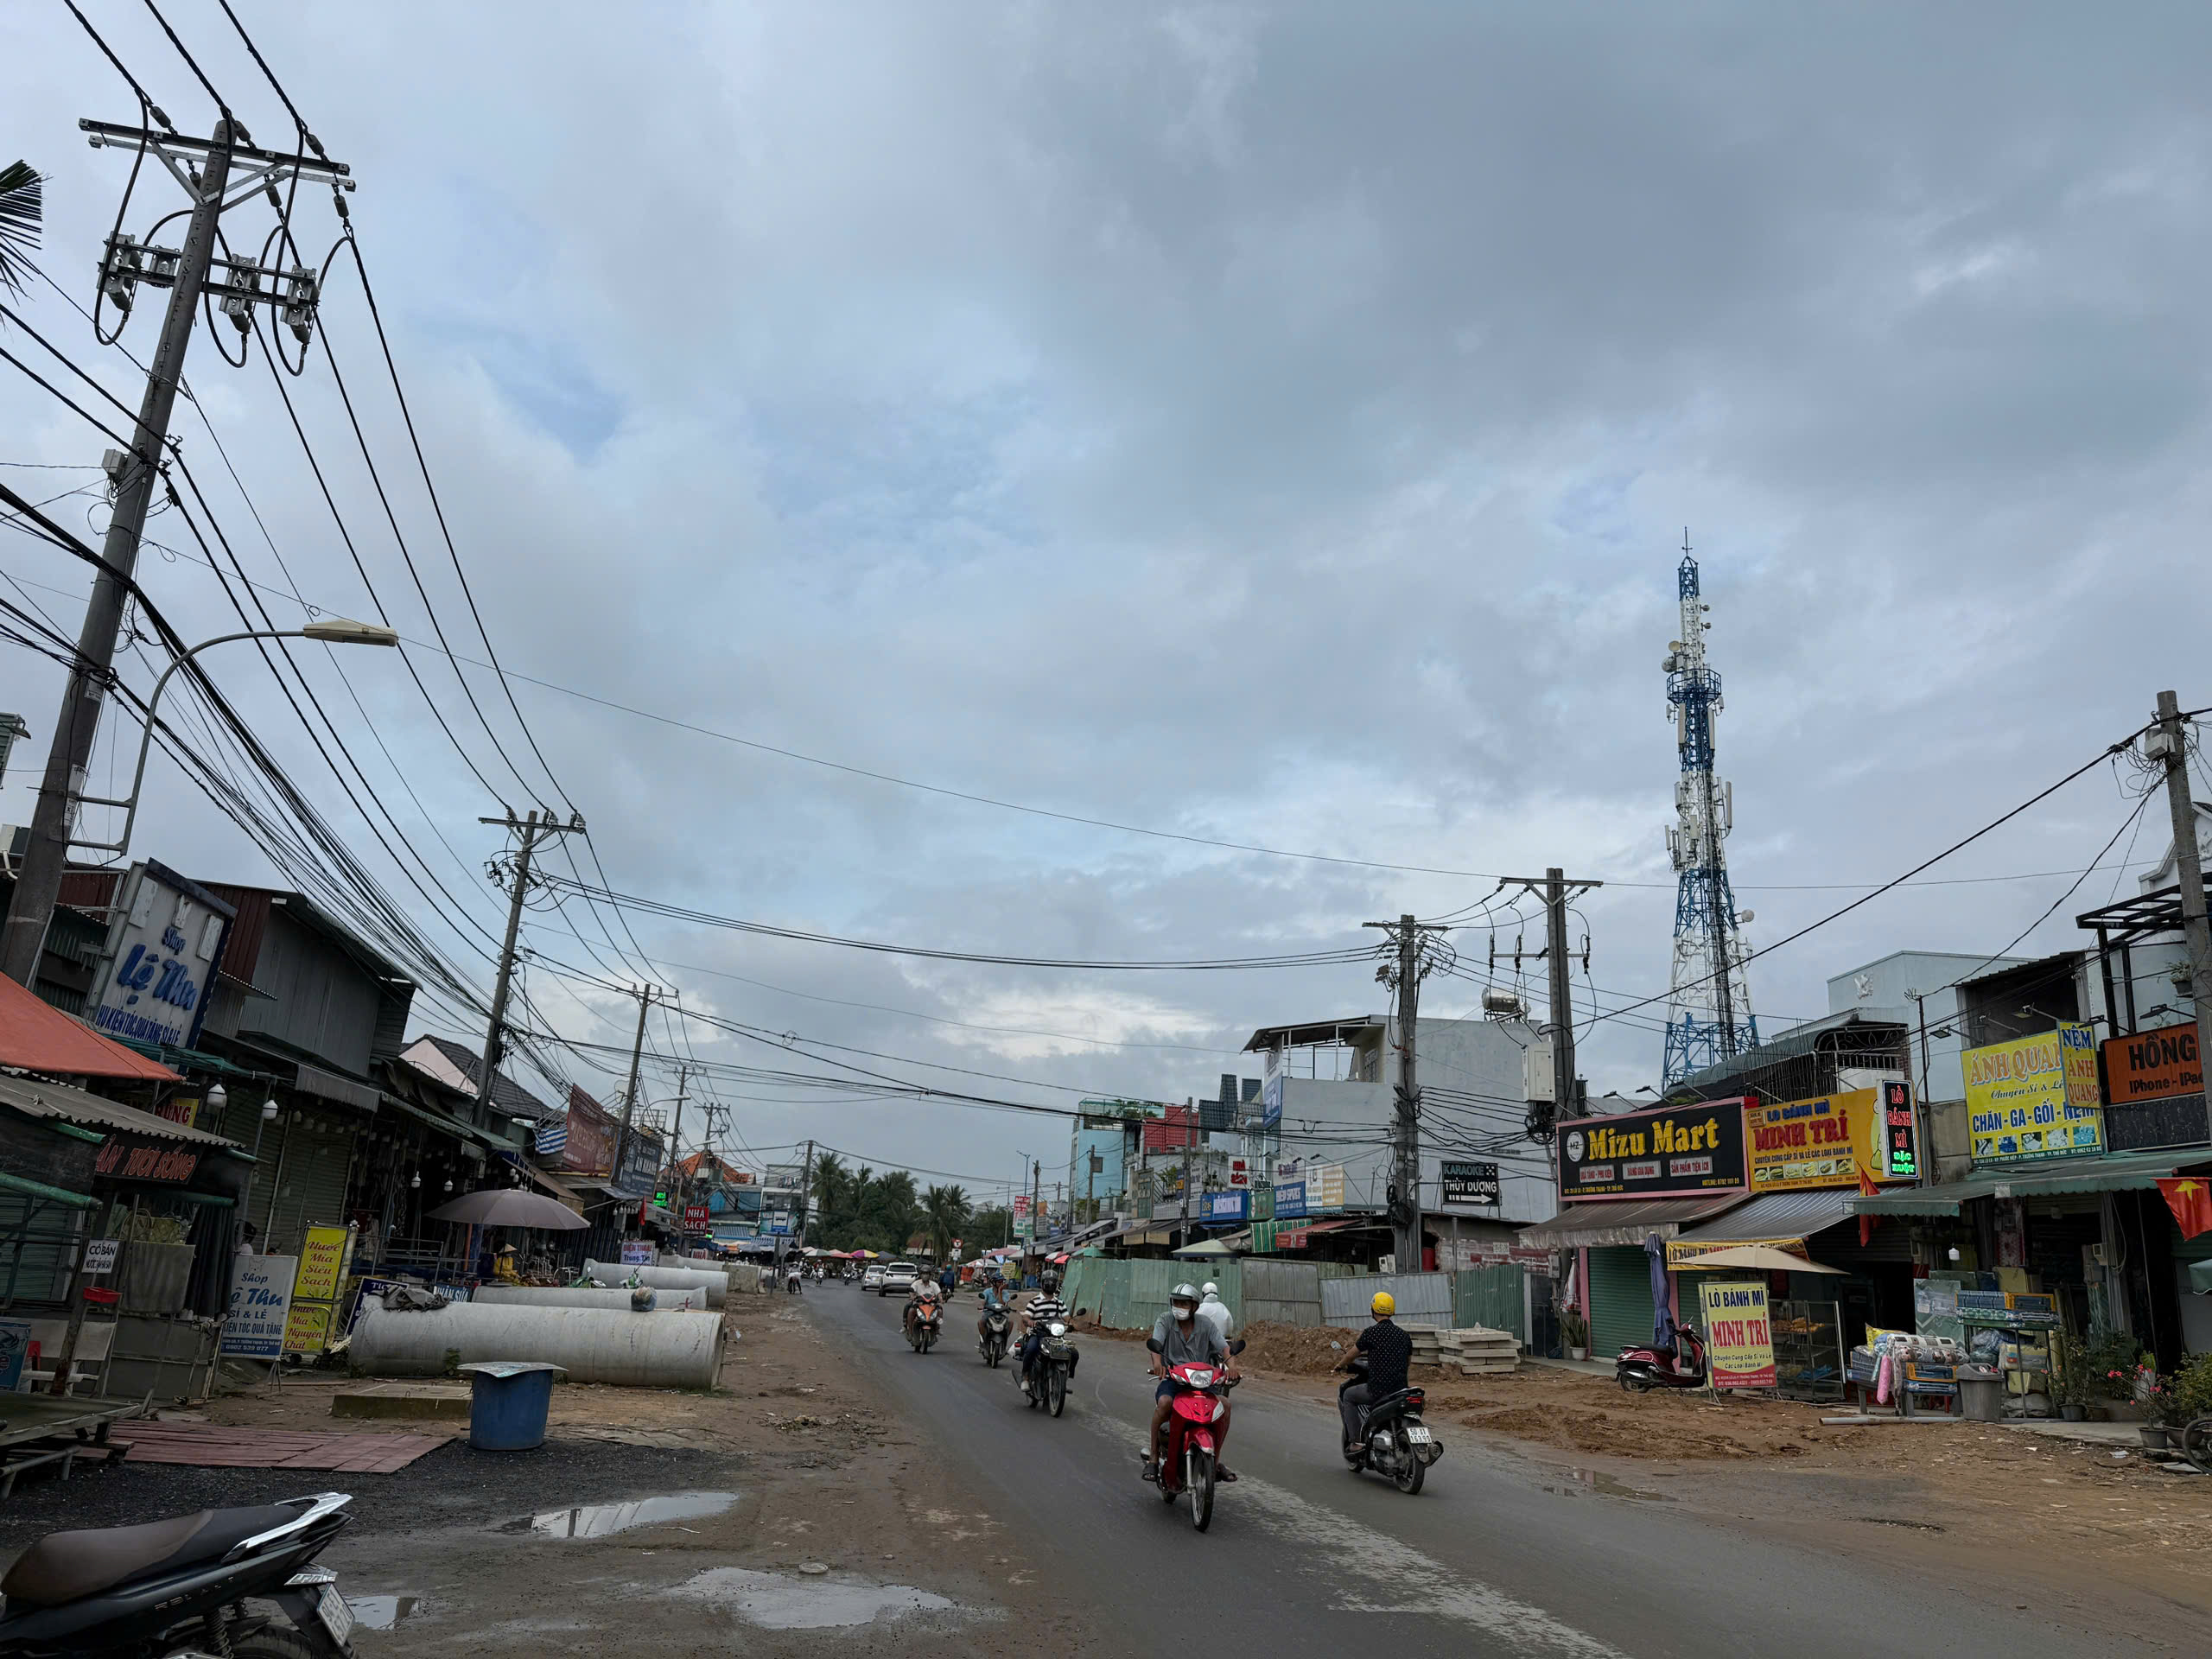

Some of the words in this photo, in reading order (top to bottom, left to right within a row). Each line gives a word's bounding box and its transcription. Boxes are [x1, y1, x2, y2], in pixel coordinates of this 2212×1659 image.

[162, 926, 186, 955] Shop
[118, 944, 159, 1005] Lệ
[153, 959, 198, 1010] Thu
[2062, 1025, 2092, 1051] NỆM
[2128, 1033, 2196, 1071] HỒNG
[1971, 1051, 2011, 1085] ÁNH
[2012, 1043, 2063, 1082] QUA
[2068, 1053, 2095, 1077] ÁNH
[1891, 1085, 1904, 1103] LÒ
[1991, 1087, 2025, 1099] Chuyên
[2068, 1084, 2101, 1103] QUANG
[2129, 1078, 2170, 1094] IPhone
[1783, 1104, 1812, 1119] BÁNH
[1815, 1098, 1829, 1114] MÌ
[1887, 1107, 1911, 1126] BÁNH
[1973, 1110, 2002, 1132] CHĂN
[2010, 1109, 2026, 1128] GA
[2033, 1098, 2055, 1124] GỐI
[1588, 1128, 1646, 1161] Mizu
[1652, 1117, 1721, 1154] Mart
[1754, 1122, 1807, 1151] MINH
[1809, 1109, 1849, 1143] TRÍ
[1895, 1129, 1907, 1147] MÌ
[122, 1147, 161, 1178] TƯƠI
[153, 1141, 197, 1180] SỐNG
[1783, 1151, 1792, 1161] CẤP
[1444, 1164, 1484, 1176] KARAOKE
[1680, 1160, 1691, 1173] PHẨM
[1467, 1179, 1497, 1192] DƯƠNG
[687, 1207, 705, 1218] NHÀ
[684, 1218, 705, 1230] SÁCH
[89, 1243, 101, 1255] CÓ
[101, 1243, 116, 1255] BÁN
[308, 1241, 340, 1251] Nước
[242, 1272, 268, 1284] Shop
[230, 1287, 244, 1308] ệ
[248, 1288, 283, 1306] Thu
[1709, 1287, 1720, 1307] LÒ
[1723, 1287, 1750, 1306] BÁNH
[1751, 1287, 1764, 1306] MÌ
[255, 1308, 267, 1319] LẺ
[238, 1321, 250, 1332] TÓC
[251, 1322, 264, 1334] QUÀ
[266, 1322, 283, 1337] TẶNG
[1712, 1320, 1745, 1347] MINH
[1746, 1311, 1769, 1346] TRÍ
